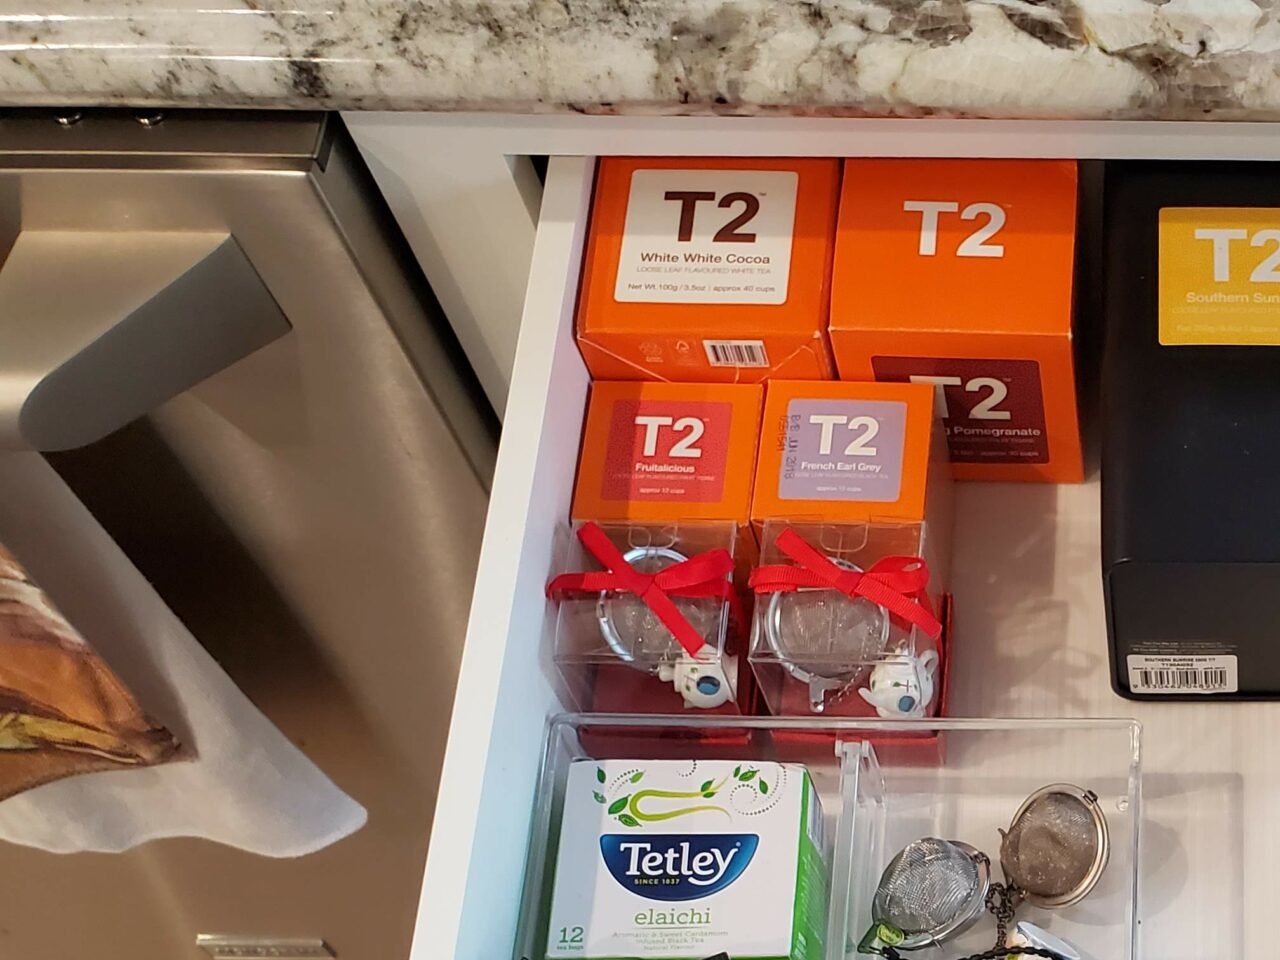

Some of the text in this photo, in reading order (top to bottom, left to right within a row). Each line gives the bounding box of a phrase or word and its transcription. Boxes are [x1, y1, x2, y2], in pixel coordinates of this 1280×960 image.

[664, 191, 760, 243] T2
[904, 201, 1006, 258] T2
[641, 253, 770, 265] White White Cocoa
[1186, 292, 1249, 304] Southern
[635, 416, 705, 458] T2
[810, 415, 879, 456] T2
[953, 426, 1041, 437] Pomegranate
[636, 463, 695, 473] Fruitalicious
[801, 462, 881, 473] French Earl Grey
[620, 842, 738, 886] Tetley
[634, 908, 711, 926] elaichi
[559, 927, 583, 943] 12
